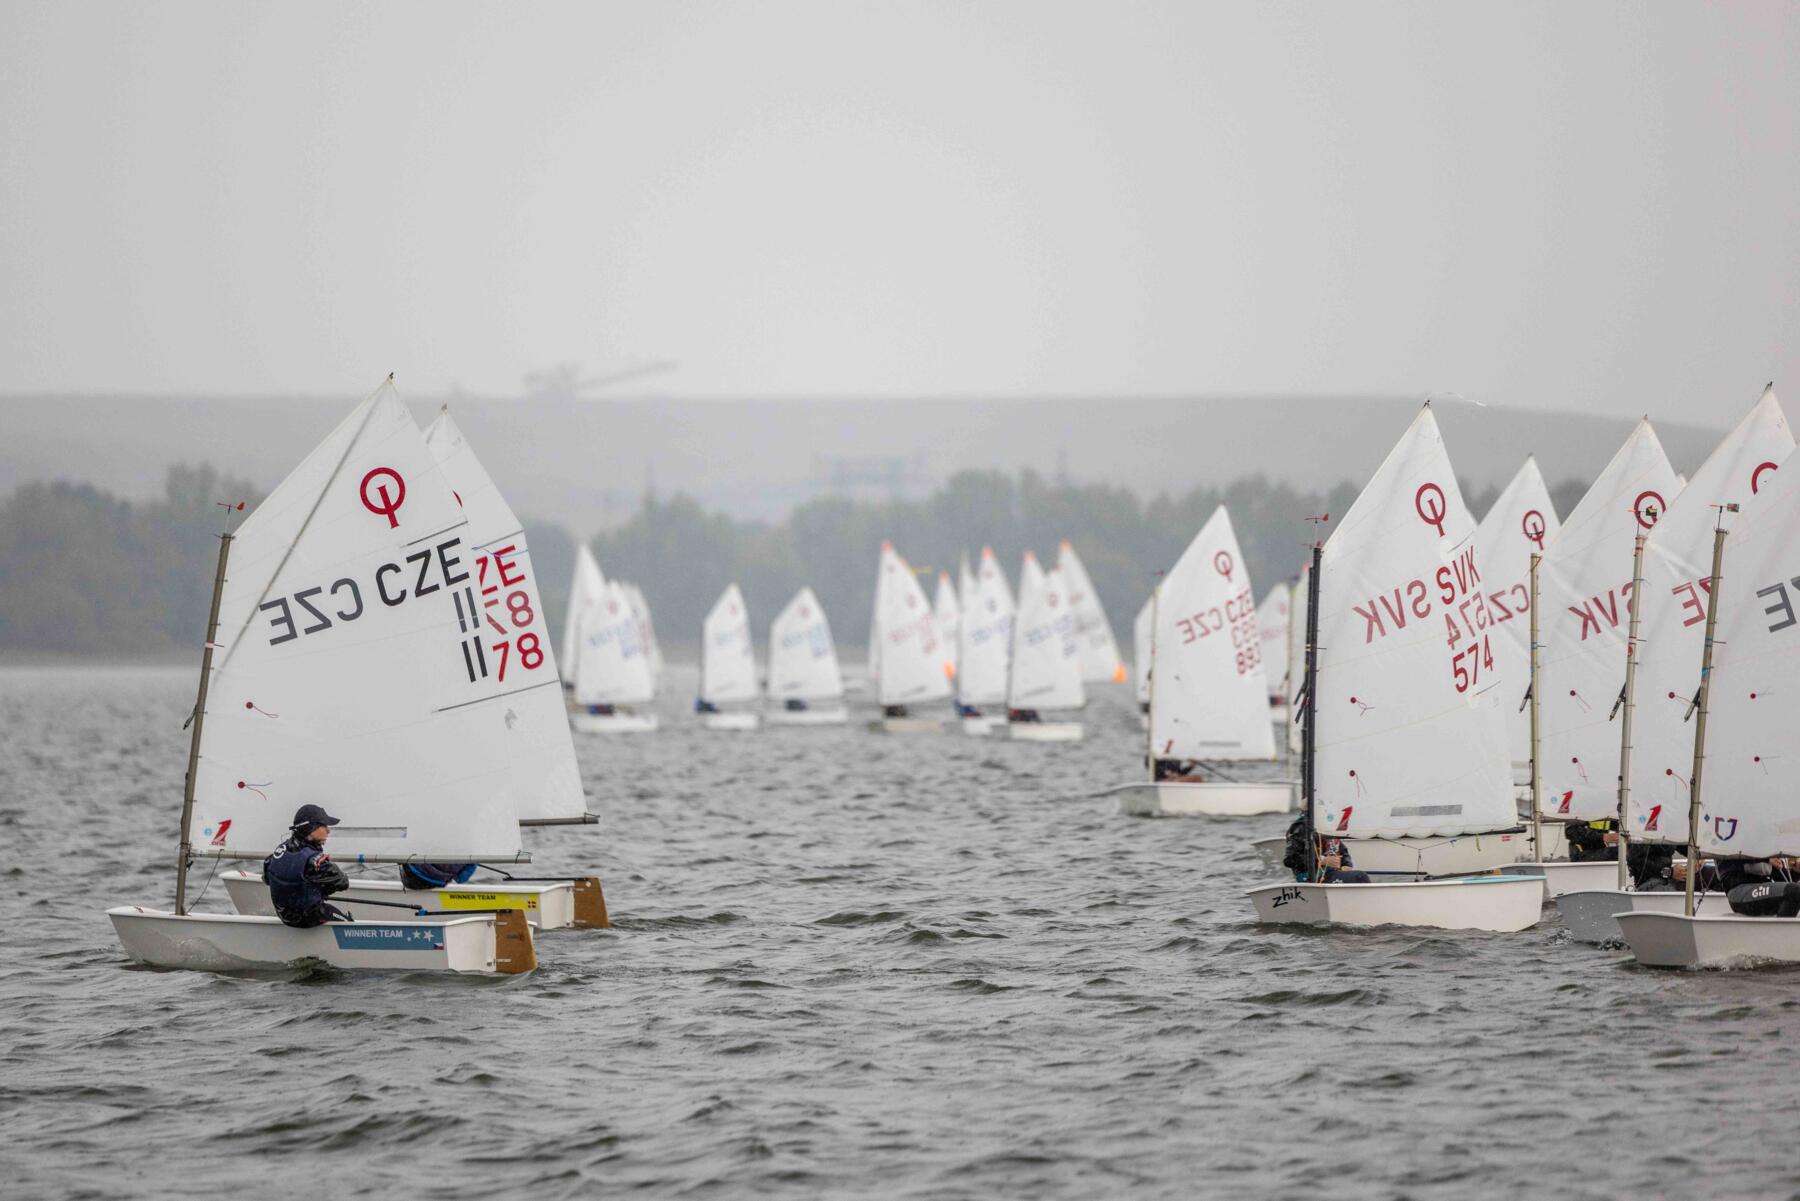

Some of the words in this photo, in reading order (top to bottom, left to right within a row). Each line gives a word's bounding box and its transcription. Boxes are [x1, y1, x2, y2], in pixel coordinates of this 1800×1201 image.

[375, 537, 470, 606] CZE
[1436, 545, 1480, 605] SVK
[1453, 633, 1493, 693] 574
[1752, 886, 1770, 898] Gill
[344, 929, 378, 938] WINNER
[379, 929, 403, 938] TEAM
